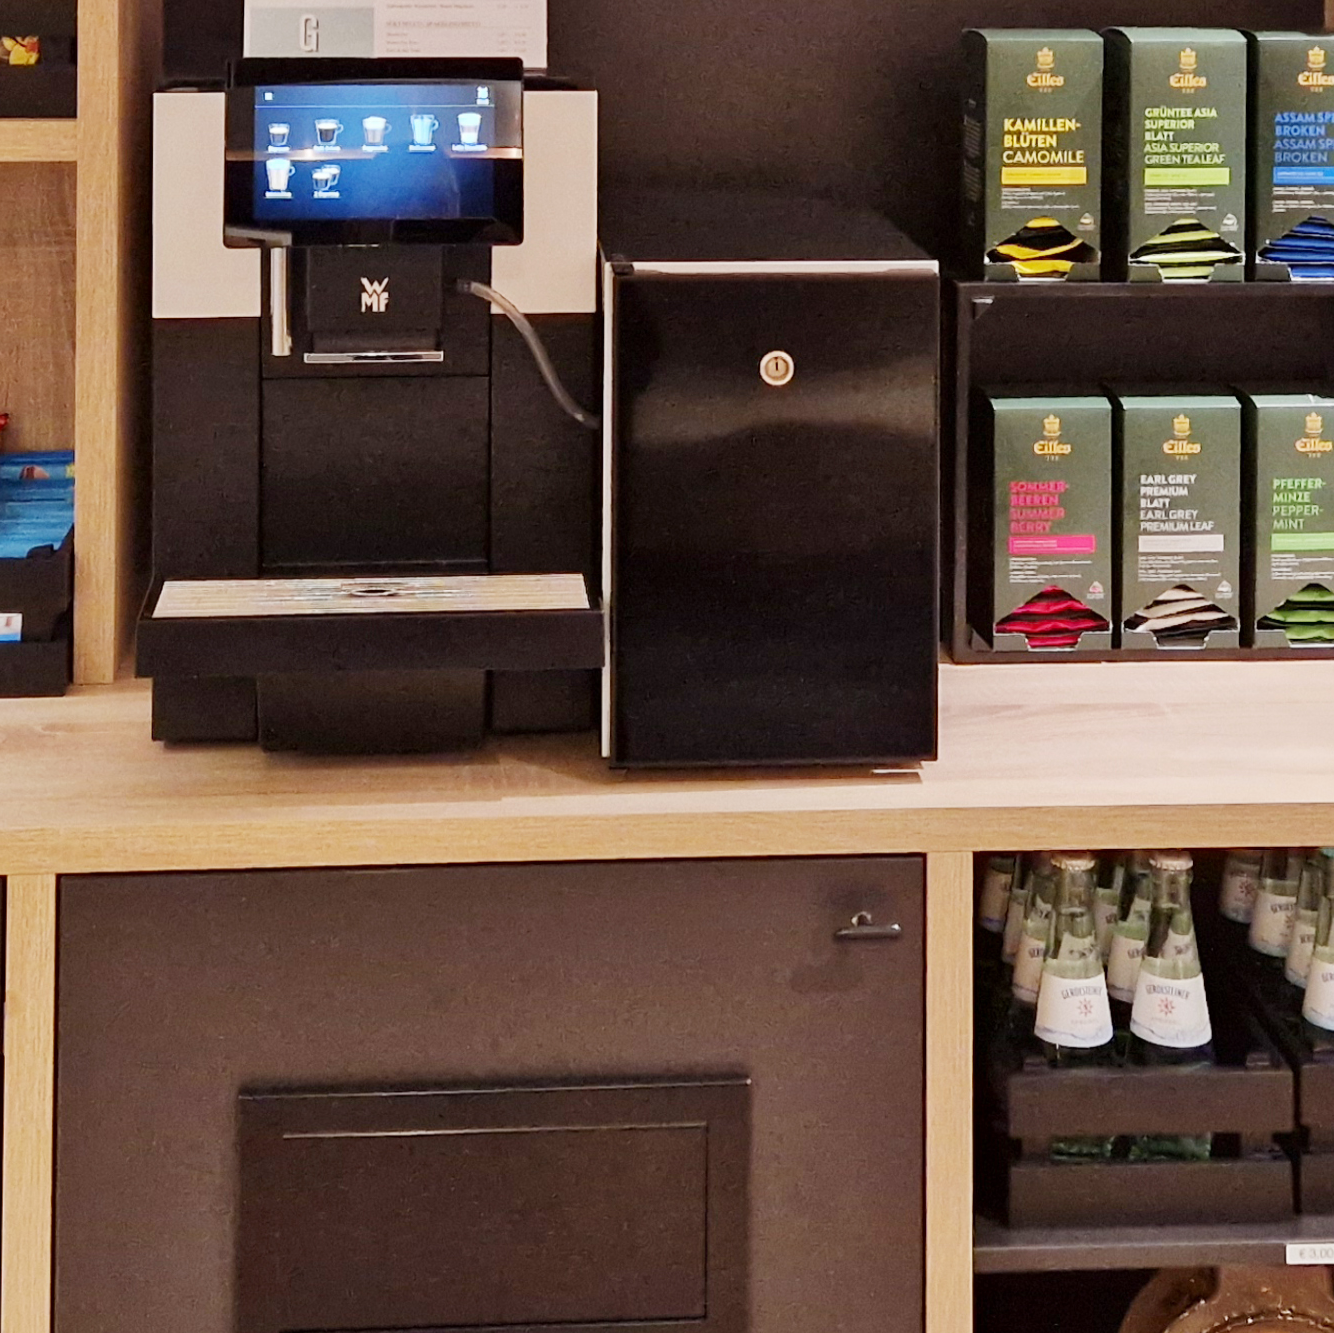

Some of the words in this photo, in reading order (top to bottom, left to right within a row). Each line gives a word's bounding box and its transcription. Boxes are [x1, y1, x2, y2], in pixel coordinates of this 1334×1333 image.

[1195, 107, 1218, 118] ASIA
[1274, 113, 1316, 123] ASSAM
[1003, 118, 1082, 132] KAMILLEN-
[1144, 120, 1195, 130] SUPERIOR
[1275, 125, 1326, 136] BROKEN
[1003, 131, 1057, 148] BLÜTEN
[1144, 131, 1174, 142] BLATT
[1169, 142, 1220, 153] SUPERIOR
[1274, 139, 1317, 150] ASSAM
[1002, 150, 1085, 164] CAMOMILE
[1144, 154, 1180, 165] GREEN
[1182, 154, 1202, 165] TEA
[1202, 154, 1225, 165] LEAF
[1275, 152, 1328, 163] BROKEN
[1140, 474, 1168, 485] EARL
[1168, 474, 1197, 485] GREY
[1272, 478, 1326, 490] PFEFFER-
[1010, 481, 1069, 493] SOMMER-
[1140, 486, 1189, 496] PREMIUM
[1010, 494, 1059, 506] BEEREN
[1140, 497, 1171, 508] BLATT
[1272, 492, 1311, 503] MINZE
[1140, 509, 1168, 520] EARL
[1169, 509, 1198, 520] GREY
[1272, 505, 1324, 516] PEPPER-
[1010, 521, 1052, 533] BERRY
[1140, 521, 1189, 532] PREMIUM
[1190, 521, 1215, 532] LEAF
[1272, 519, 1305, 530] MINT
